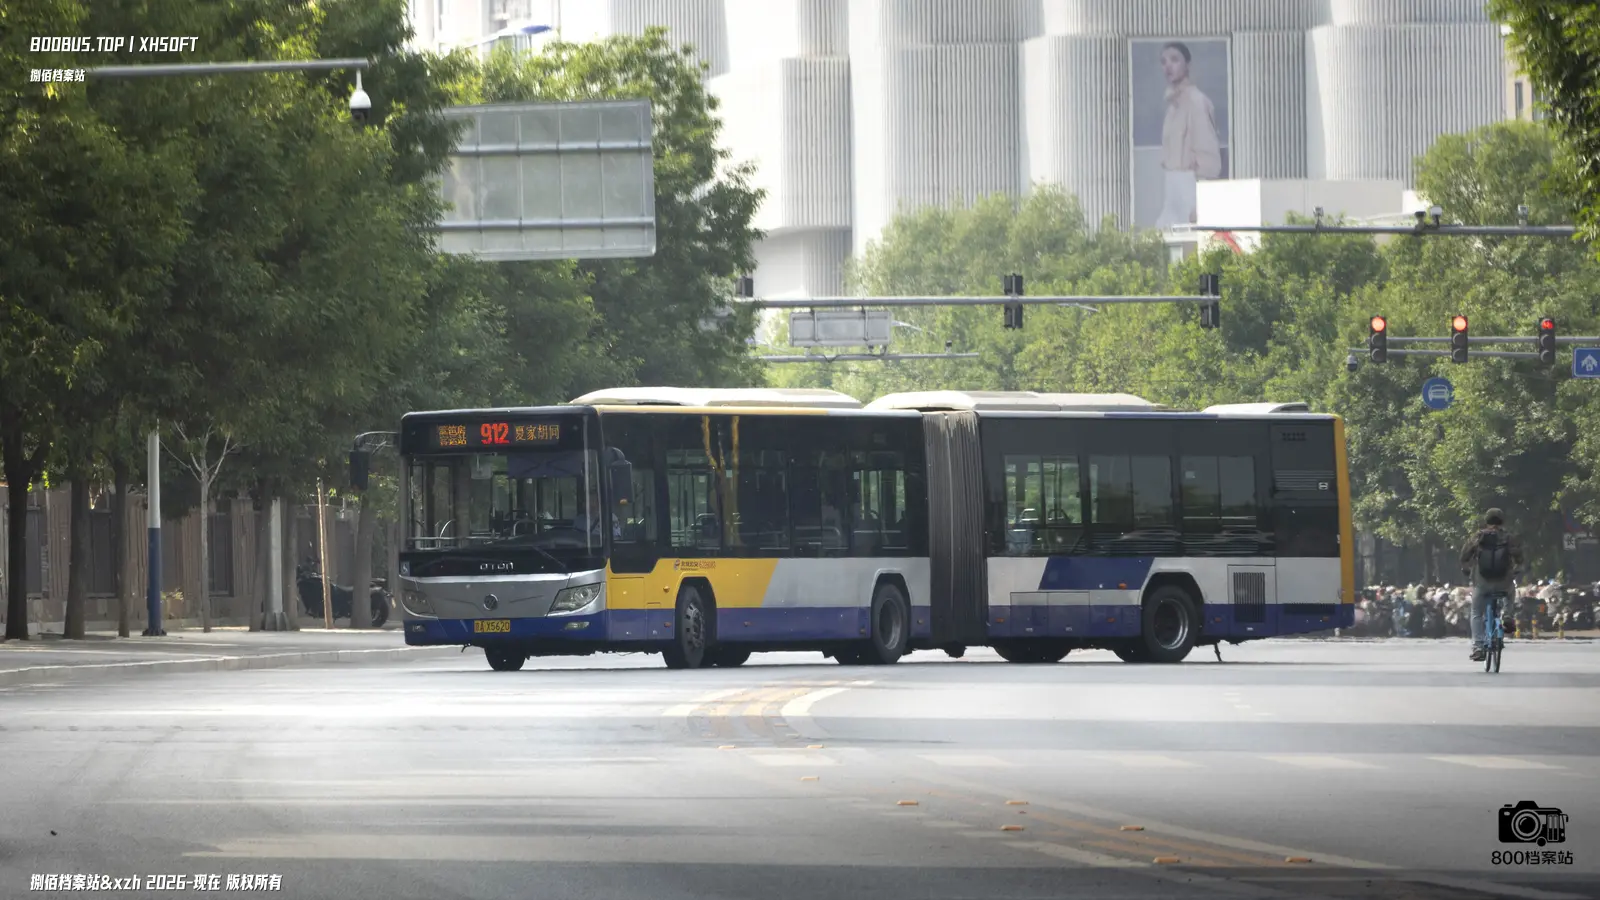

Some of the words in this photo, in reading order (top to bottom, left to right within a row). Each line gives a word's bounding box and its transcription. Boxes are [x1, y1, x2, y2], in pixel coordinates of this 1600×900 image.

[480, 423, 510, 444] 912
[515, 425, 560, 441] 夏家胡同
